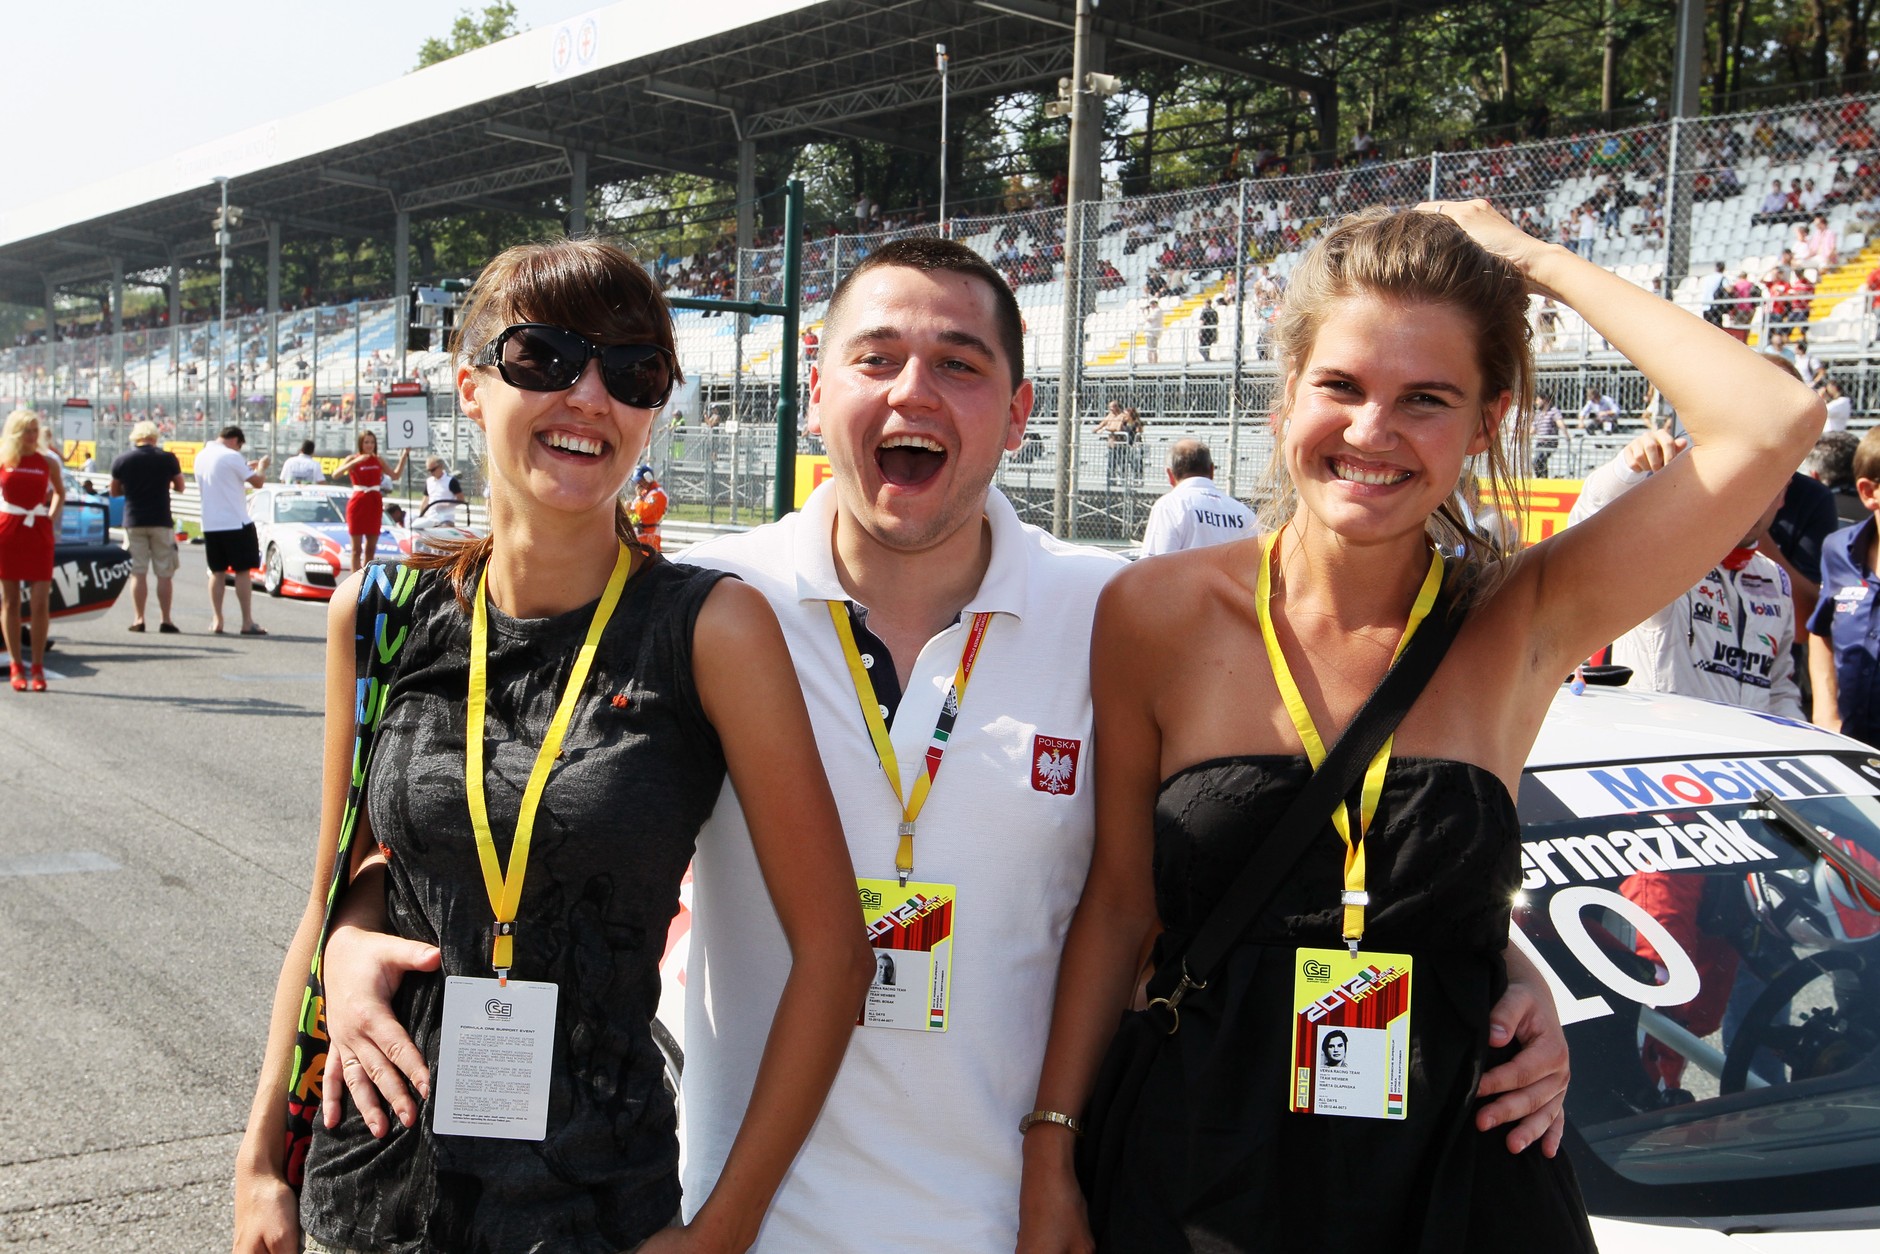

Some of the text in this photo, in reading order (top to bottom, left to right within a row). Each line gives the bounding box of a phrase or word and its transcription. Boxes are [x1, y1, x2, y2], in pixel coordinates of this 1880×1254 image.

[74, 421, 82, 434] 7
[402, 419, 414, 439] 9
[1195, 509, 1244, 529] VELTINS
[1038, 737, 1076, 750] POLSKA
[1587, 760, 1788, 811] Mobil
[1298, 974, 1372, 1023] 2012
